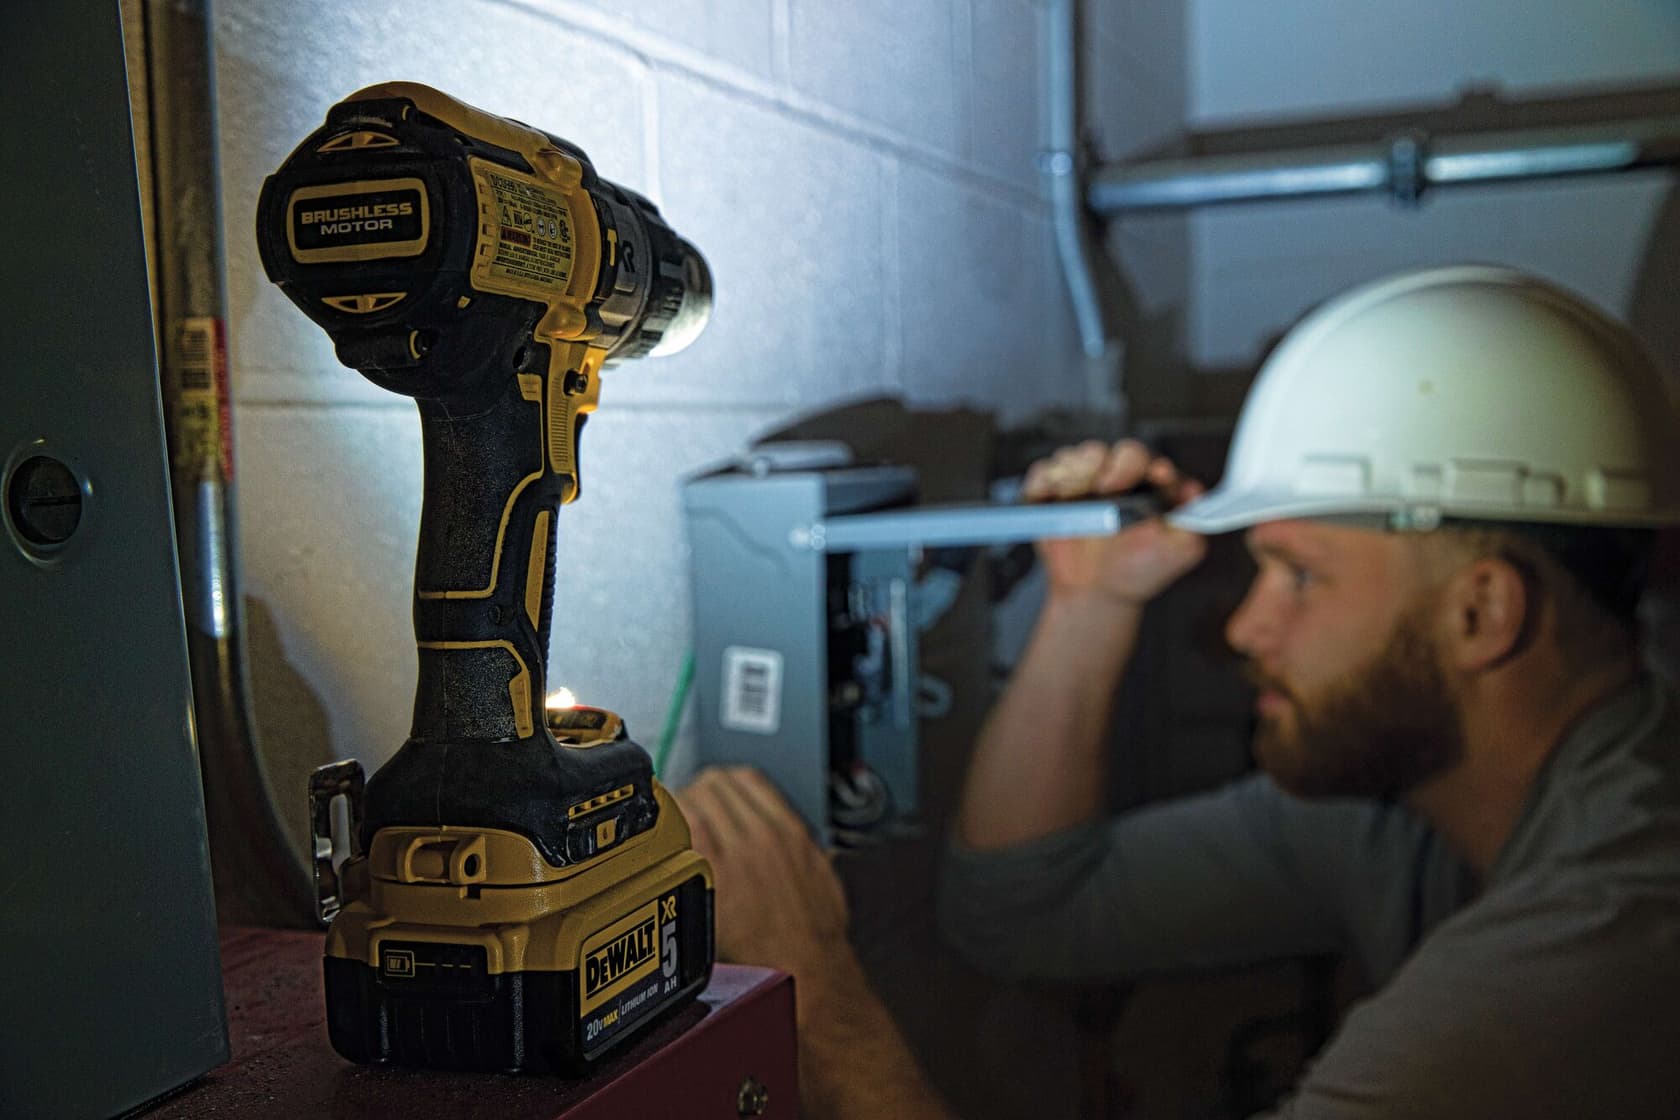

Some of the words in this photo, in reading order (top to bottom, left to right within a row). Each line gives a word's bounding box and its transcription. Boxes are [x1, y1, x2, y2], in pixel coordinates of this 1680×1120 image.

[301, 202, 413, 225] BRUSHLESS
[320, 218, 393, 236] MOTOR
[661, 896, 677, 924] XR
[661, 919, 678, 978] 5
[664, 976, 677, 994] AH
[621, 990, 647, 1015] LITHIUM
[647, 984, 659, 998] ION
